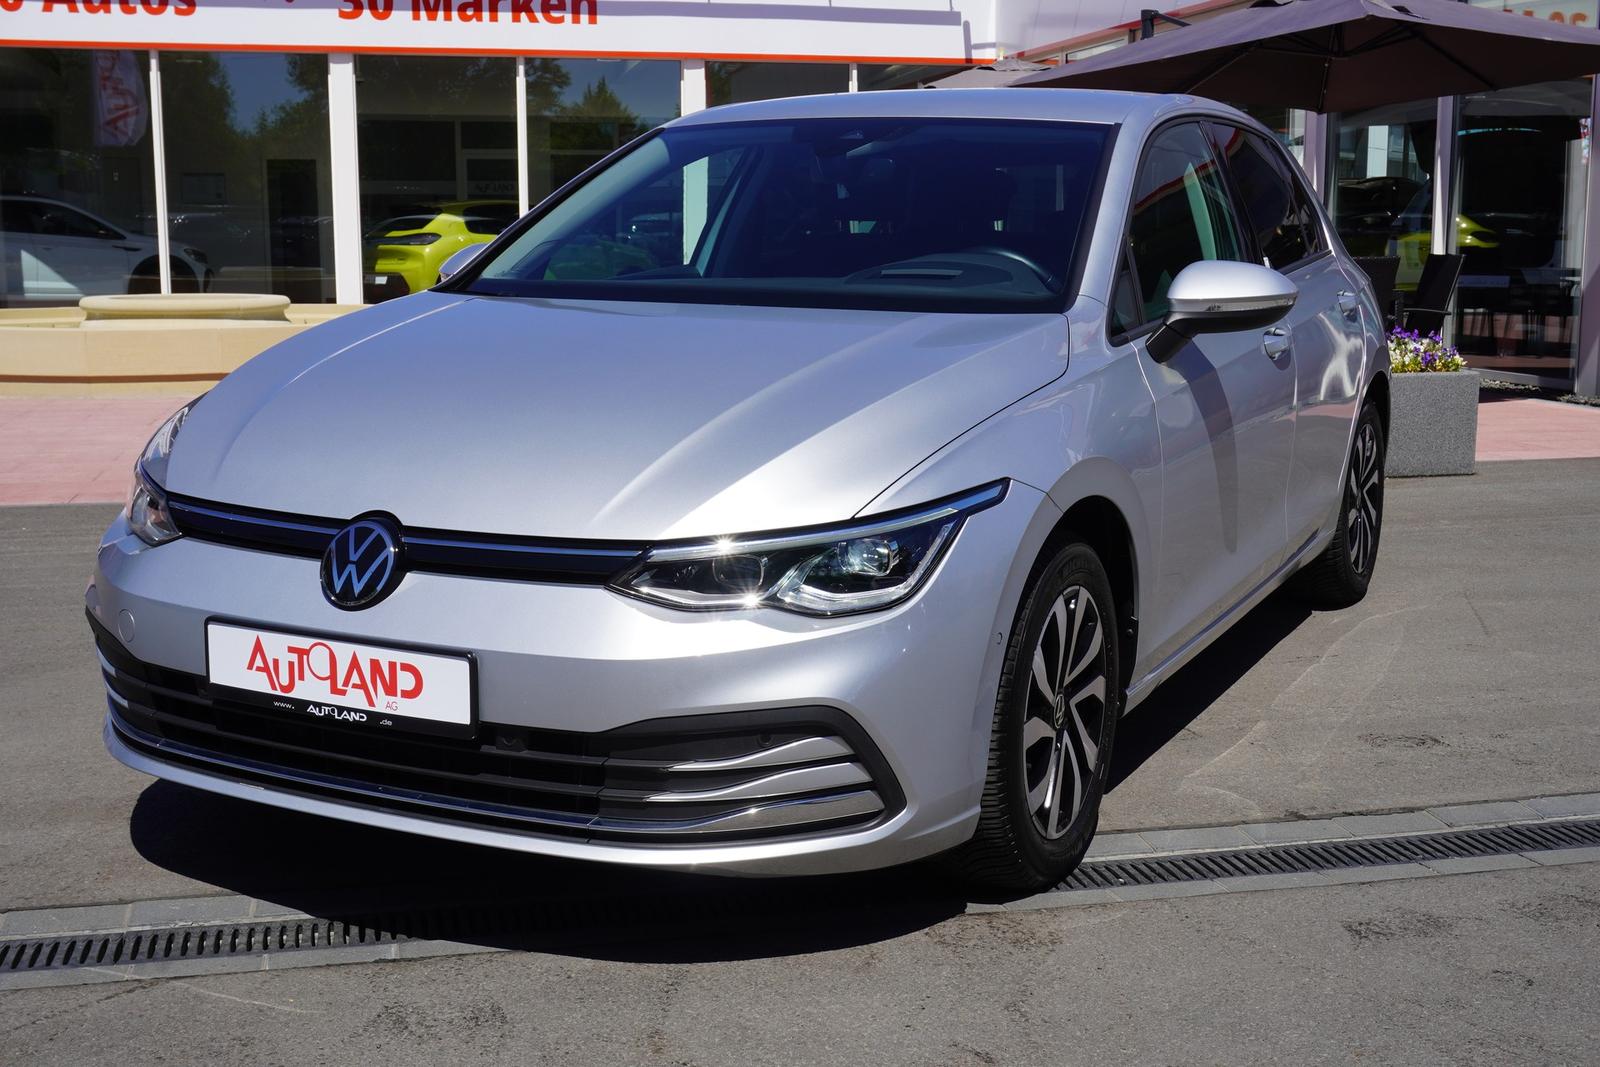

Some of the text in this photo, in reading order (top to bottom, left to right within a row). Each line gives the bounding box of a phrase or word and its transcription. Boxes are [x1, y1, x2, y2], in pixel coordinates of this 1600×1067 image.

[411, 0, 598, 25] Marken
[247, 634, 424, 707] AUTOLAND
[385, 701, 399, 711] AG
